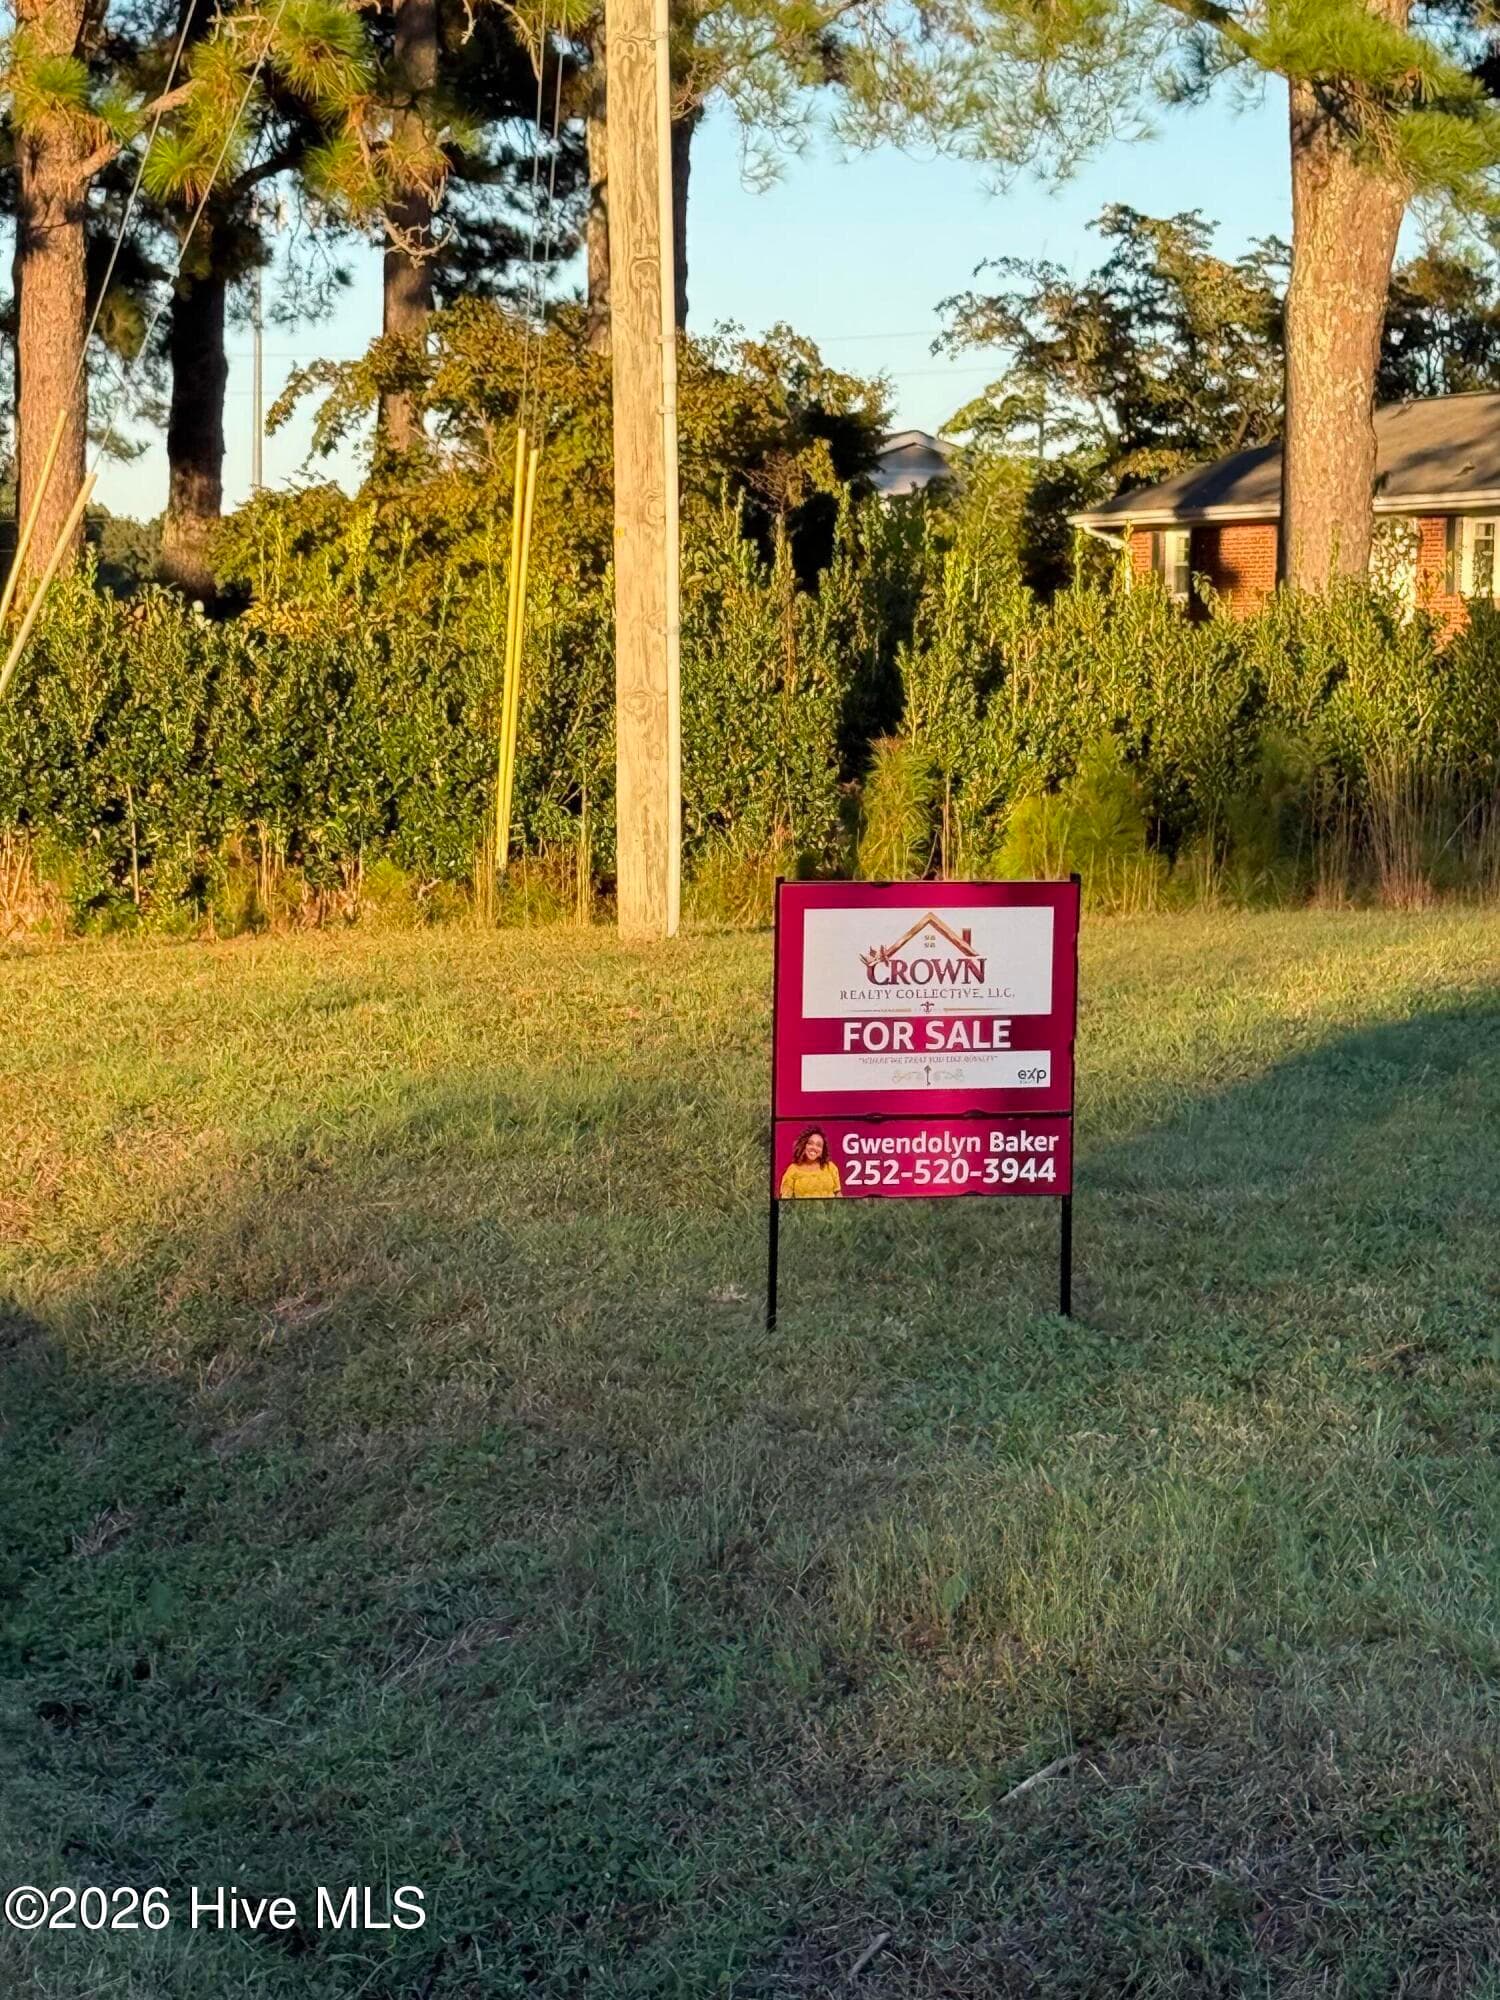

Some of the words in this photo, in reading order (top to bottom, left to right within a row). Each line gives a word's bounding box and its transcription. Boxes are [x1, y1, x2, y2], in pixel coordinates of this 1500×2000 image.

[865, 957, 987, 986] CROWN
[839, 990, 891, 1000] REALTY
[843, 1021, 914, 1051] FOR
[925, 1019, 1012, 1050] SALE
[842, 1131, 981, 1158] Gwendolyn
[989, 1130, 1059, 1152] Baker
[845, 1157, 1056, 1185] 252-520-3944
